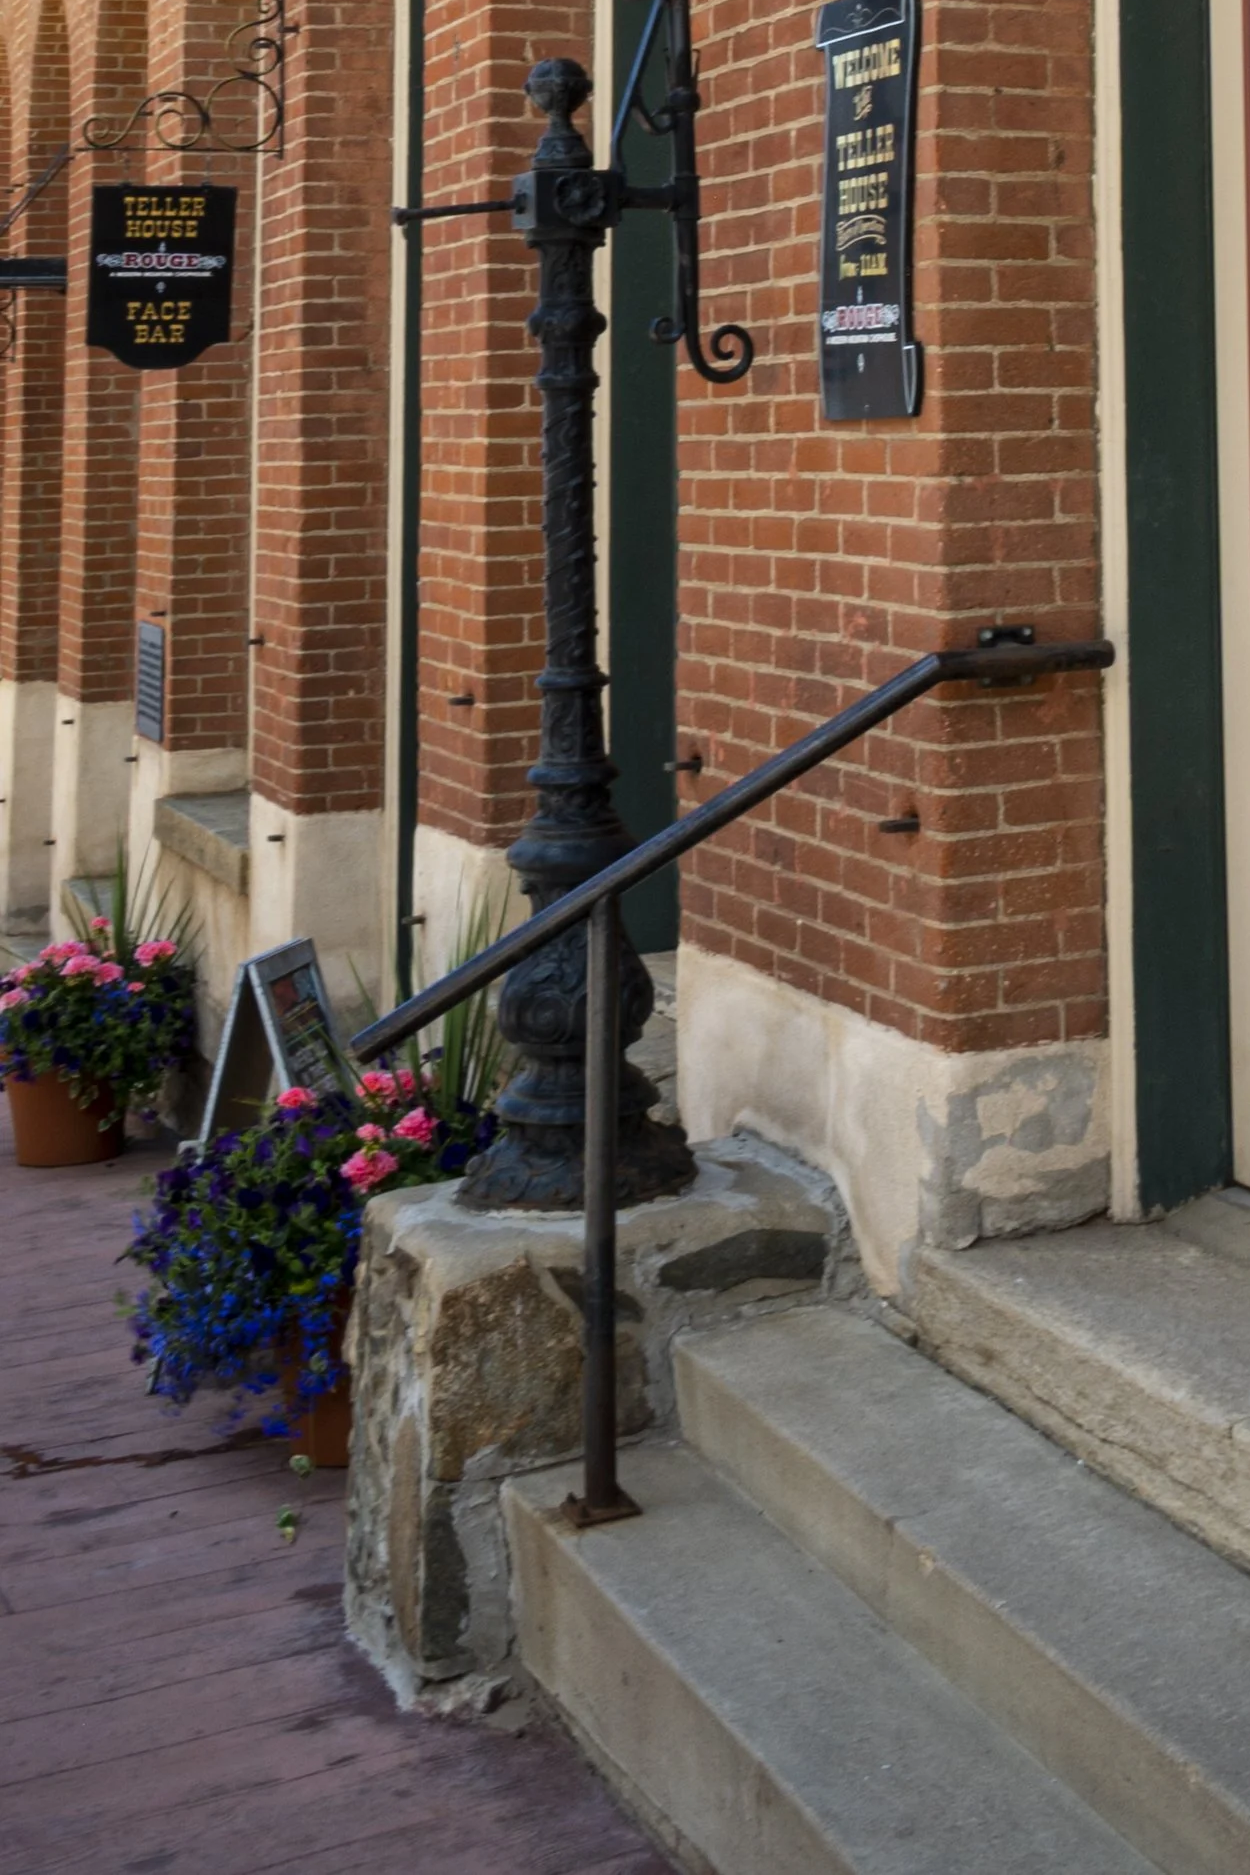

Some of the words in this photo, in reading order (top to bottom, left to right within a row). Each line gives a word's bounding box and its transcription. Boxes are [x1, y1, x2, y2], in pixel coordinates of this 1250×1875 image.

[832, 38, 901, 90] WELCOME
[836, 123, 895, 172] TELLER
[838, 172, 889, 215] HOUSE
[124, 197, 206, 217] TELLER
[125, 220, 199, 238] HOUSE
[123, 252, 201, 269] ROUGE
[126, 301, 192, 321] FACE
[835, 303, 884, 332] ROUGE
[134, 324, 186, 344] BAR
